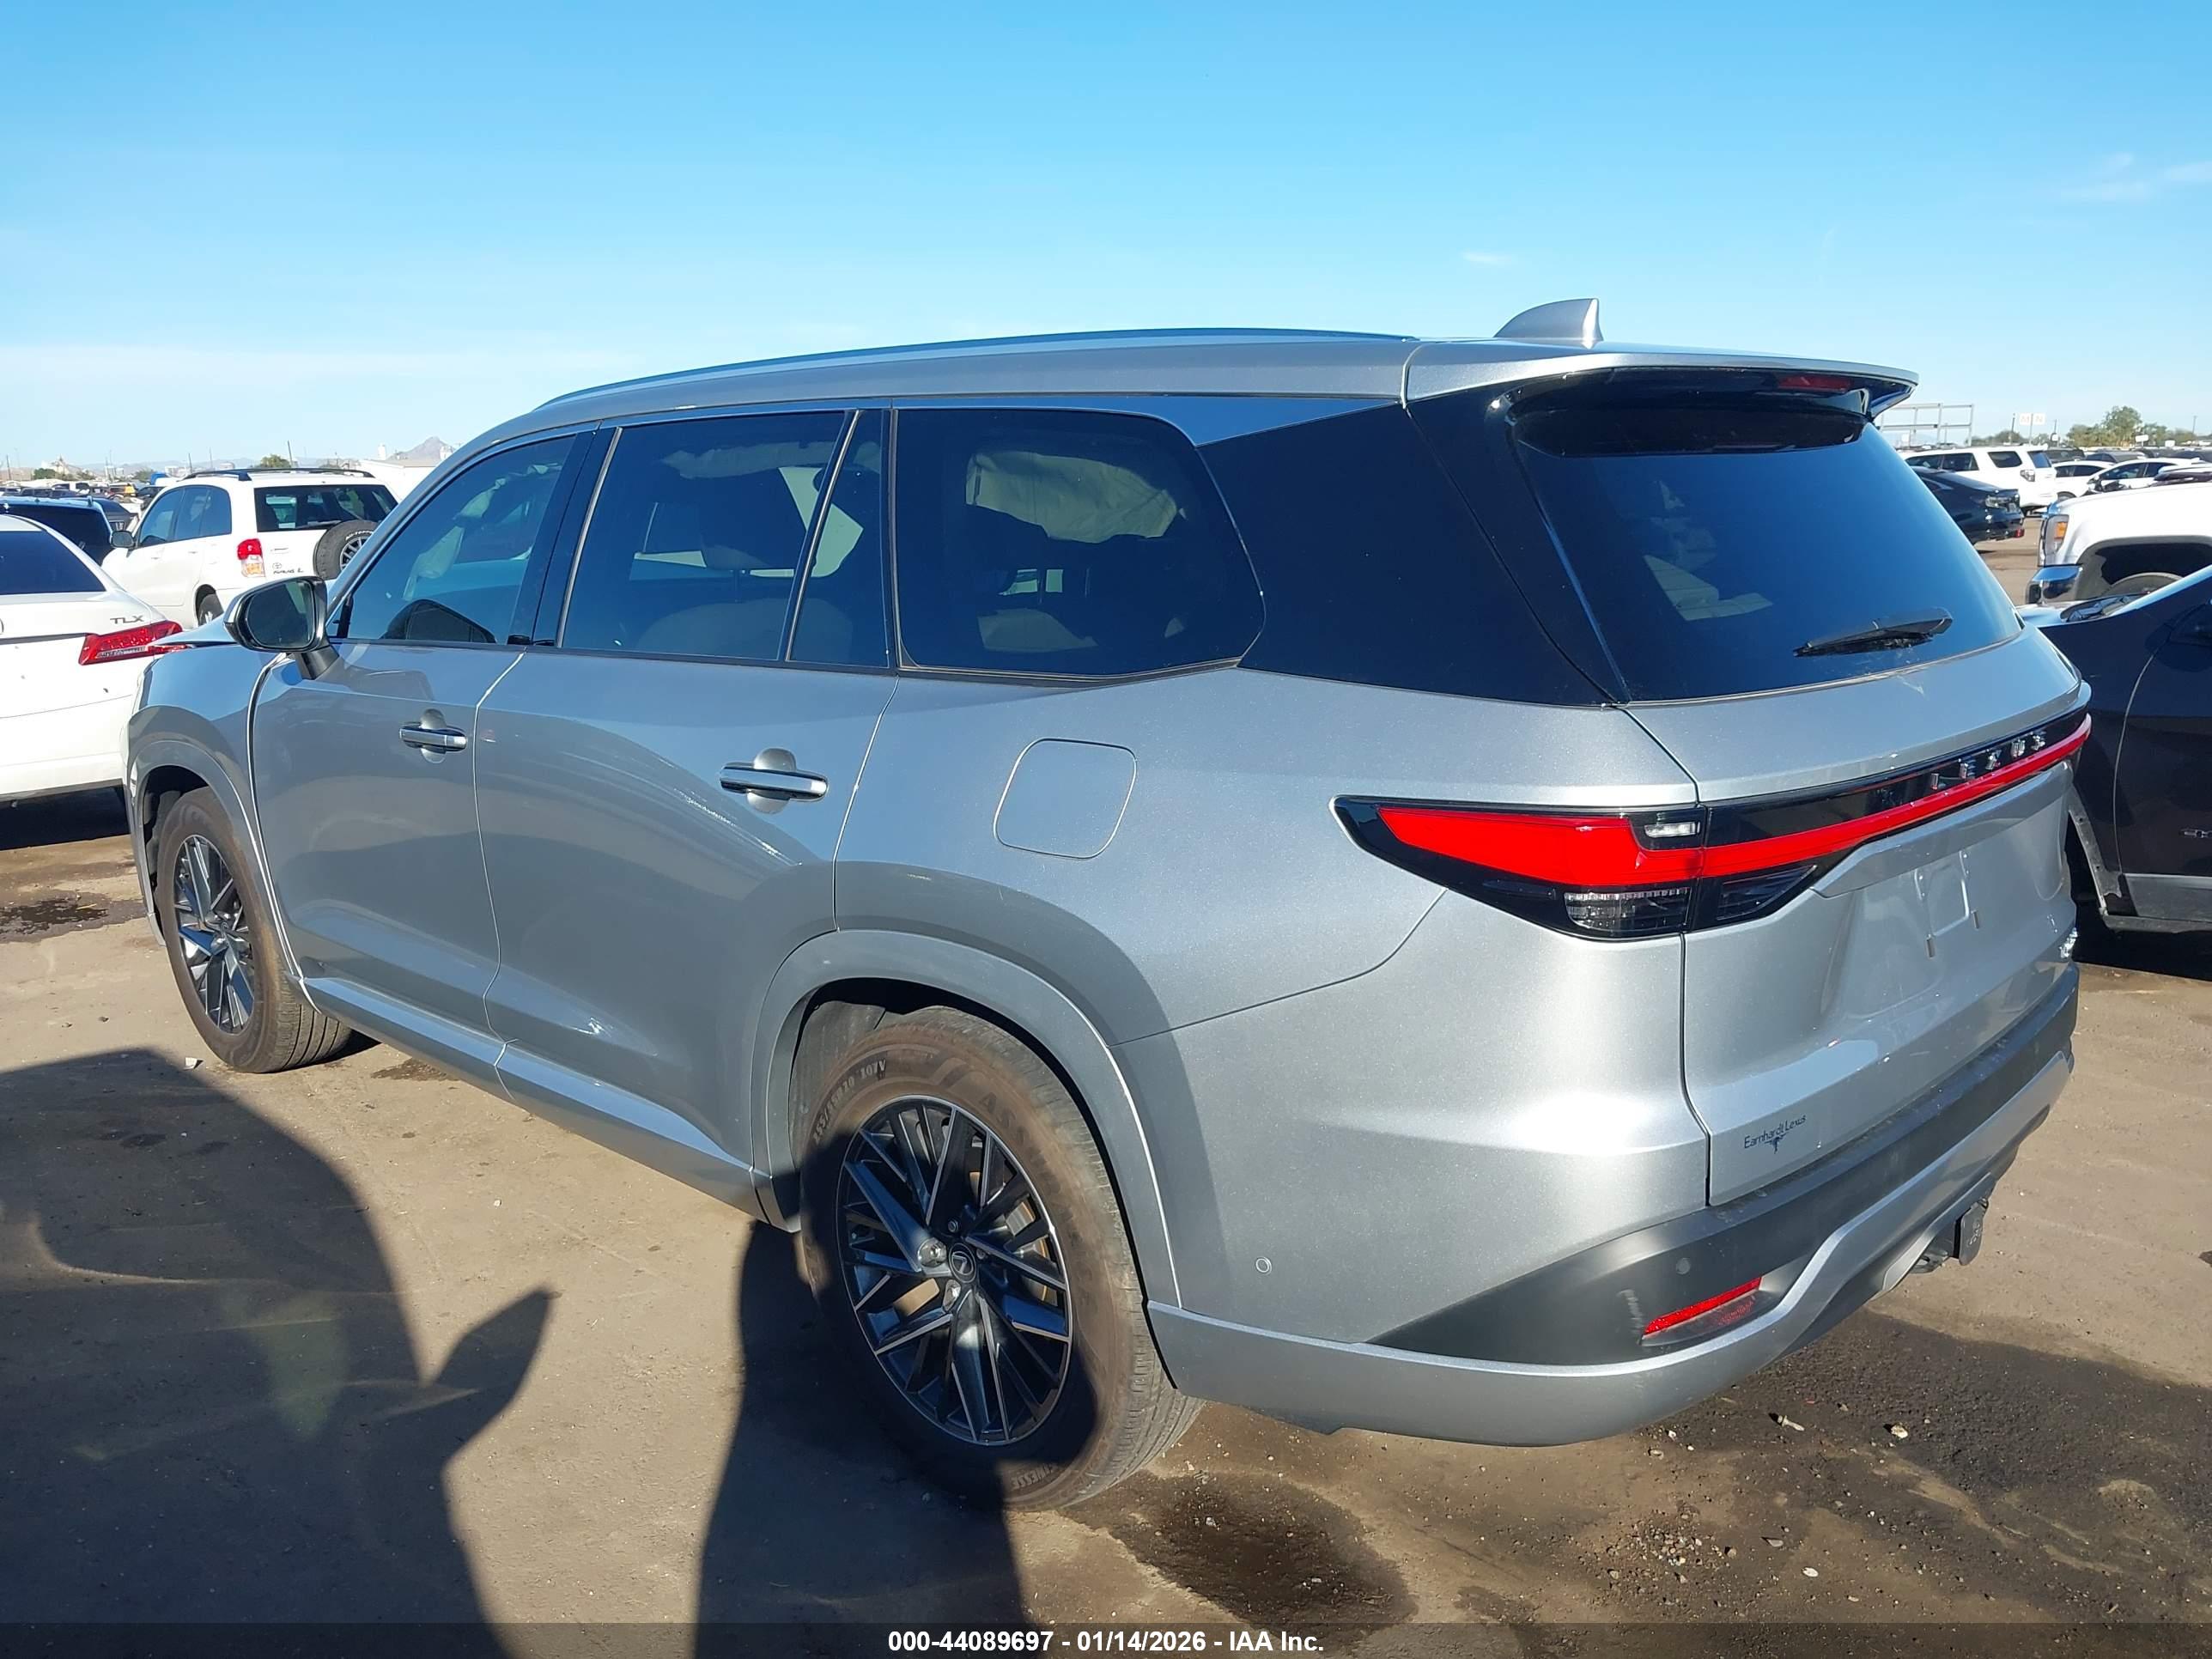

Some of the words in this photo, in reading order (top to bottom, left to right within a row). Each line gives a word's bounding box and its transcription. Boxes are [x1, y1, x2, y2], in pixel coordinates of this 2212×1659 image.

[110, 615, 144, 624] TLX
[860, 1058, 886, 1082] 107V
[1744, 1123, 1784, 1149] Earnhardt
[1784, 1115, 1807, 1132] Lexus
